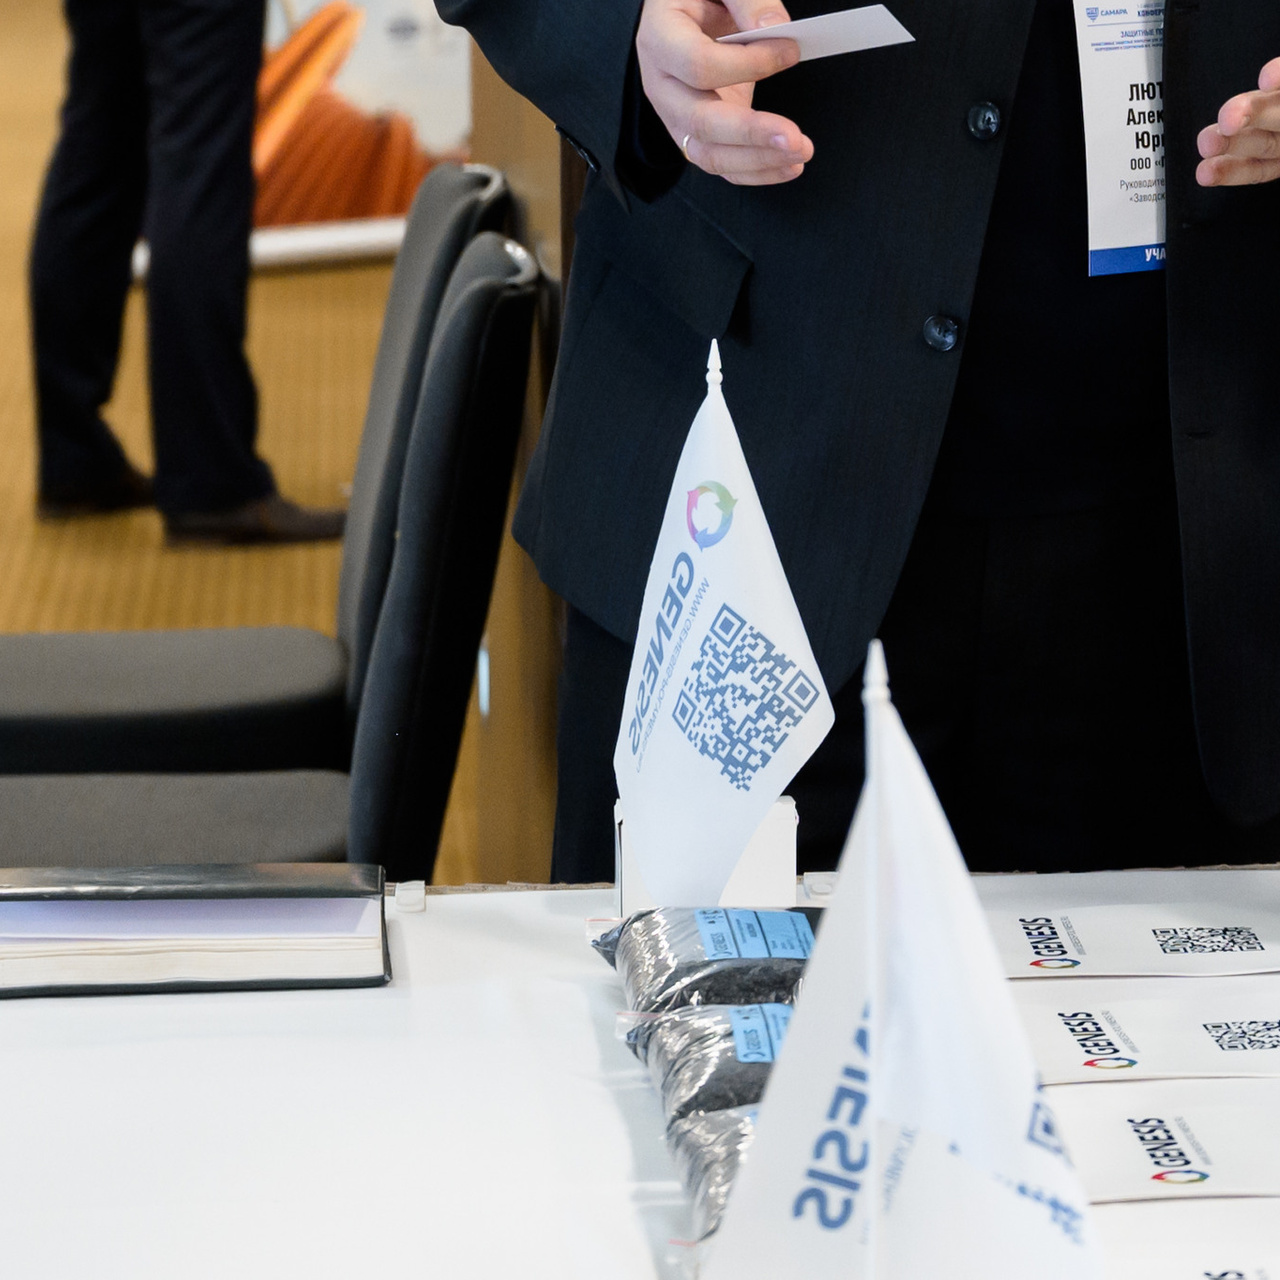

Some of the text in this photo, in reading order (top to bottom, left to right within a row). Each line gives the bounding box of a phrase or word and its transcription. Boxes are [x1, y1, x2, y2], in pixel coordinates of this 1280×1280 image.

[1100, 8, 1128, 17] САМАРА
[1018, 917, 1068, 957] GENESIS
[1057, 1011, 1121, 1056] GENESIS
[1126, 1117, 1192, 1168] GENESIS
